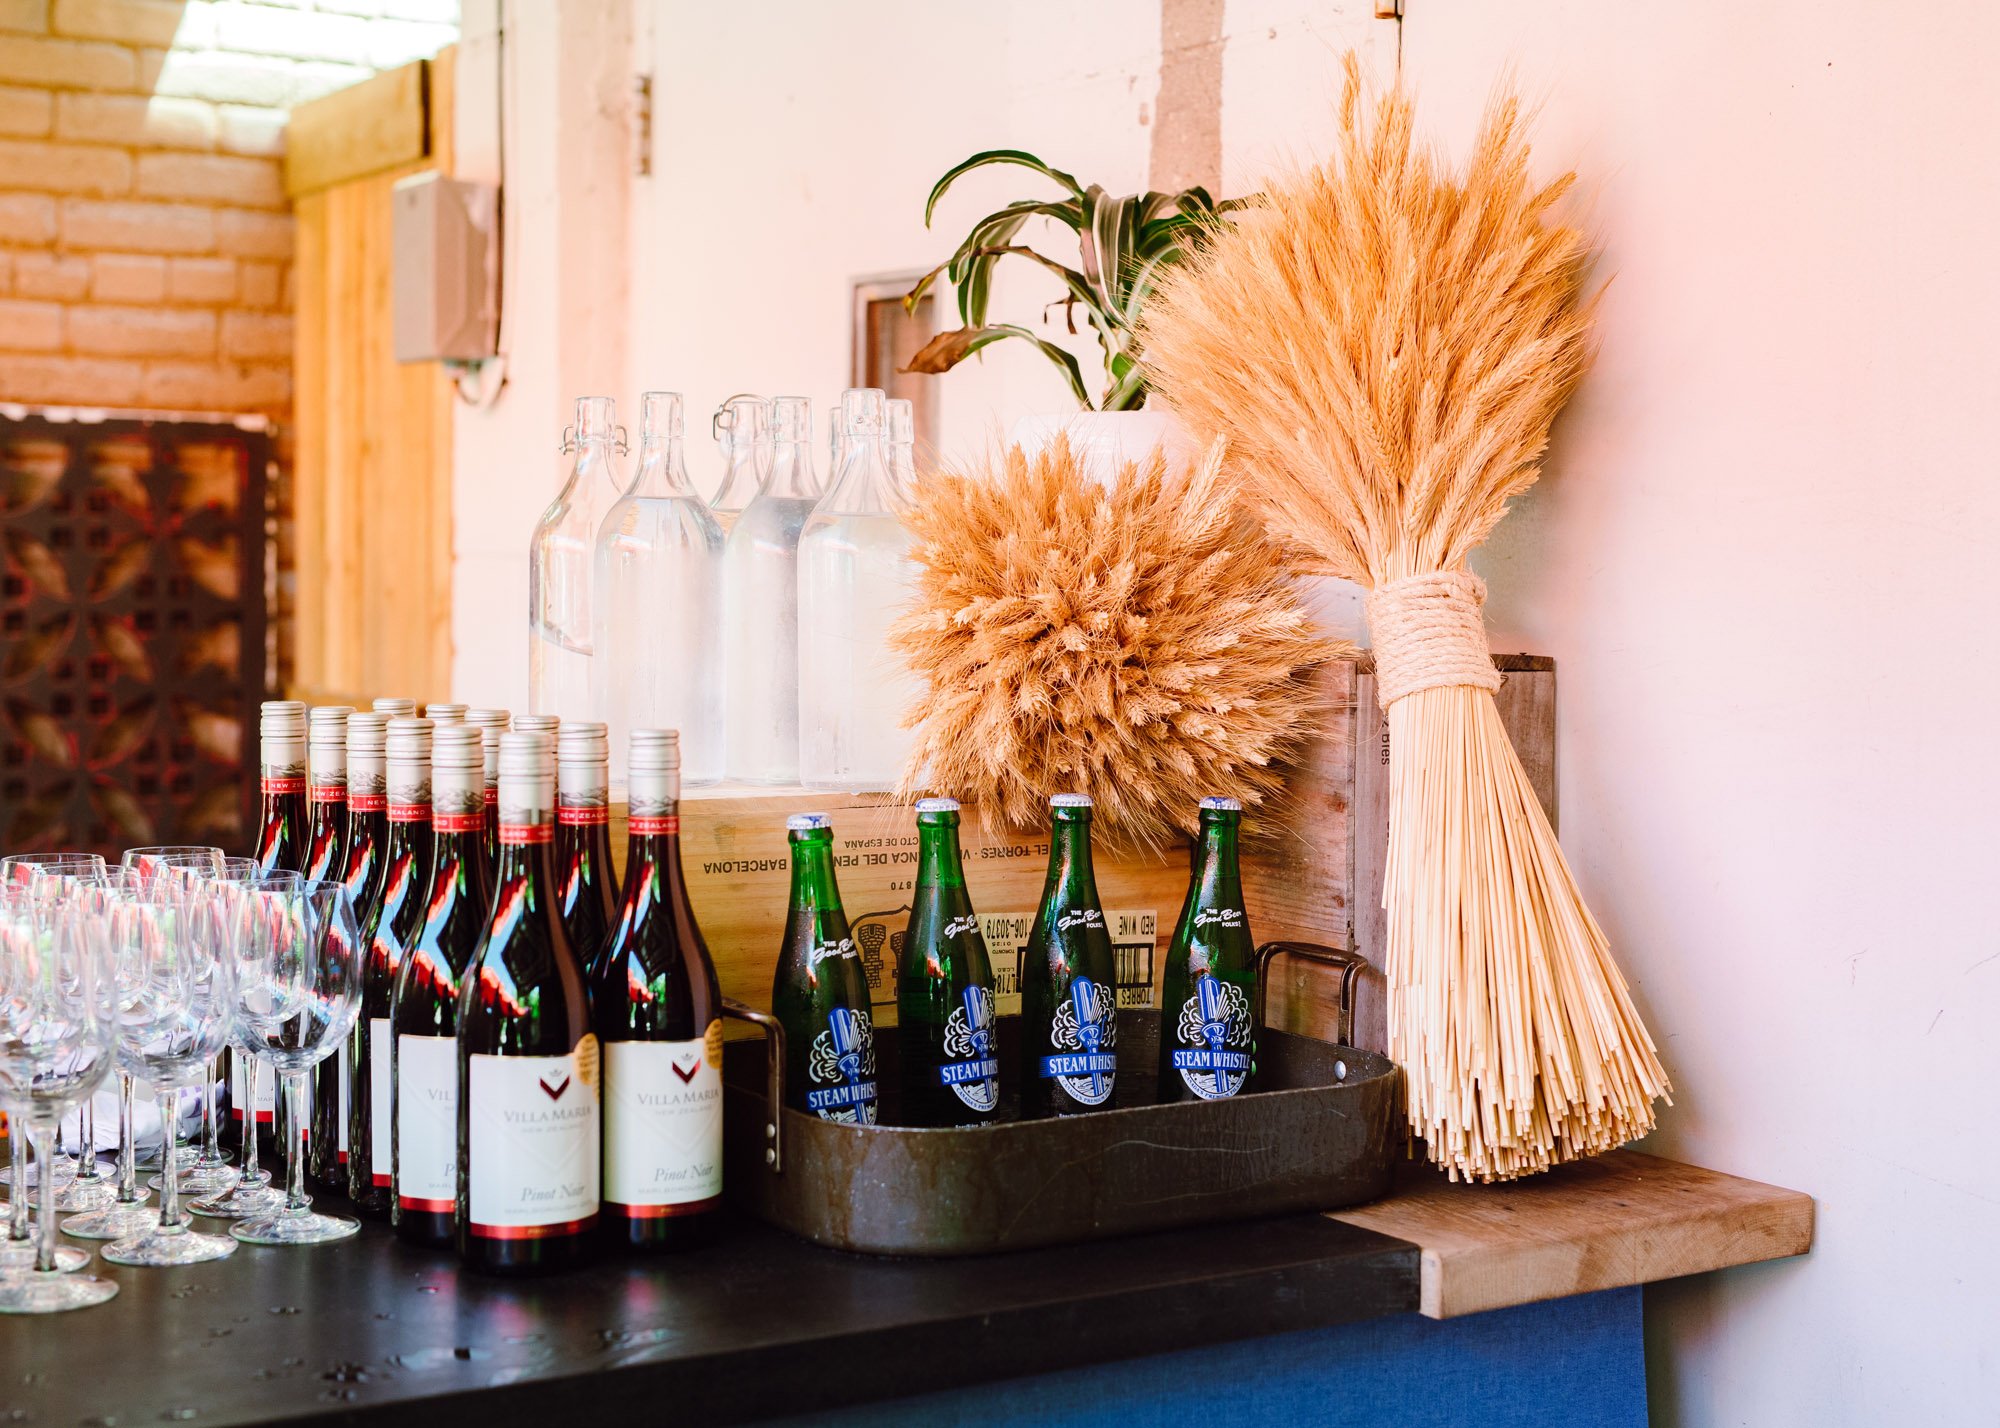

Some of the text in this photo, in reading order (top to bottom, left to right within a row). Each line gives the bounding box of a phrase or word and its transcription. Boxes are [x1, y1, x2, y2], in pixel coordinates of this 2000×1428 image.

[844, 836, 919, 850] CTO DE ESPAÑA
[981, 845, 1031, 858] TORRES
[1034, 844, 1049, 856] EL
[833, 854, 859, 867] PEN
[863, 853, 888, 866] DEL
[892, 851, 918, 863] NCA
[703, 858, 788, 874] BARCELONA
[890, 880, 914, 891] 870
[986, 918, 1033, 940] 106-30379
[1057, 915, 1087, 931] Good
[1118, 915, 1155, 936] RED WINE
[1193, 913, 1222, 928] Good
[944, 922, 970, 939] Good
[813, 946, 843, 964] Good
[1121, 988, 1150, 1006] TORRES
[1049, 1054, 1117, 1075] STEAM WHIST
[1174, 1051, 1251, 1070] STEAM WHISTLE
[942, 1059, 998, 1083] STEAM WHIS
[427, 1088, 456, 1101] VIL
[637, 1088, 720, 1105] VILLA MARIA
[808, 1087, 850, 1109] STEAM
[503, 1105, 591, 1123] VILLA MARIA
[654, 1162, 714, 1182] Pinot Noir
[520, 1182, 585, 1202] Pinot Noir
